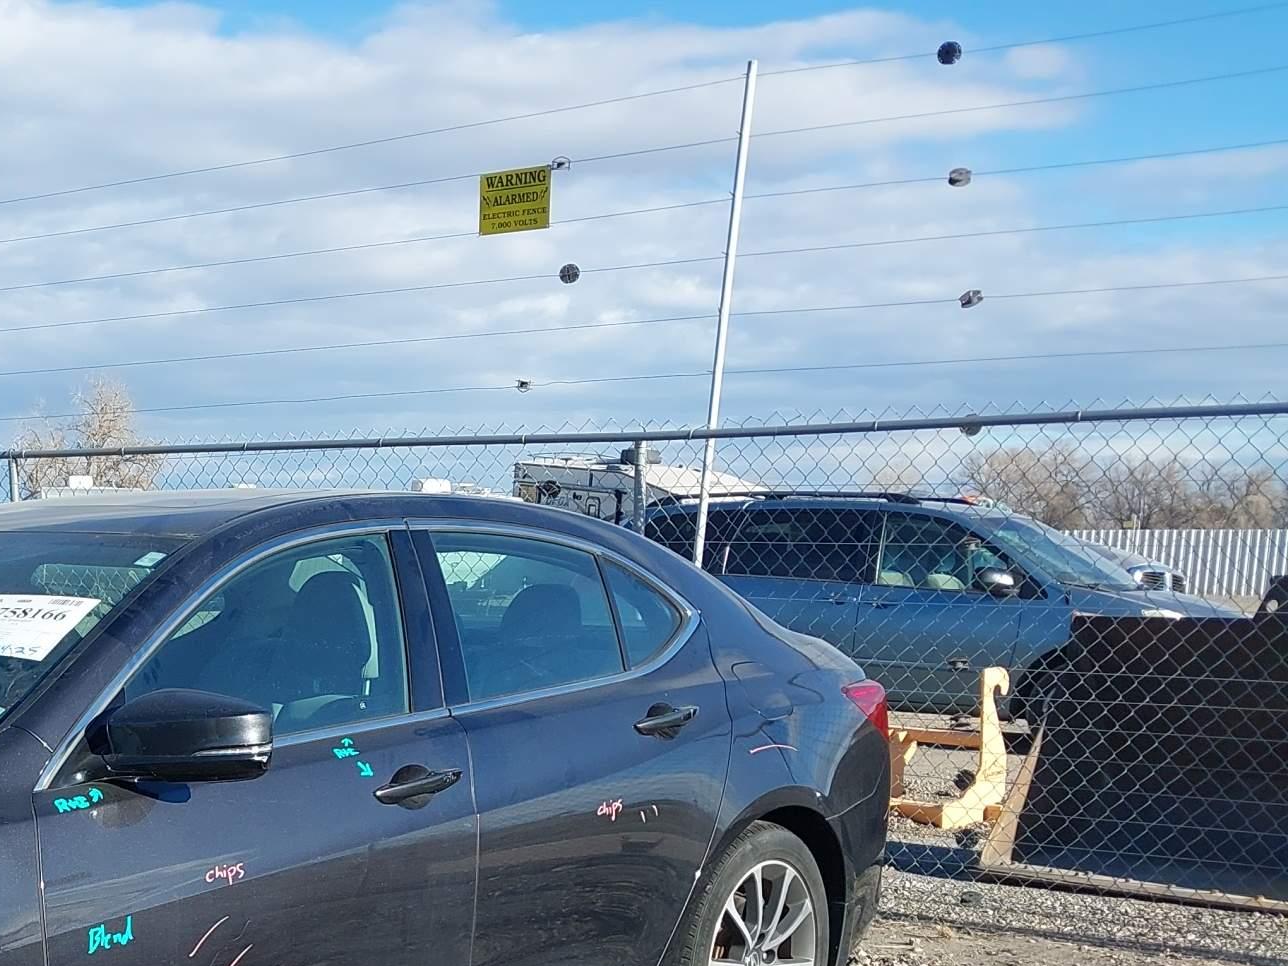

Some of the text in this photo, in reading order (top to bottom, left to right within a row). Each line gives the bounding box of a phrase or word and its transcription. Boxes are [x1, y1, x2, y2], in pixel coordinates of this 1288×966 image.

[486, 170, 546, 189] WARNING
[492, 191, 539, 207] ALARMED
[482, 207, 547, 221] ELECTRIC FENCE
[513, 218, 538, 226] VOLTS
[597, 799, 623, 821] chips
[205, 863, 245, 886] chips
[88, 915, 134, 954] Blend
